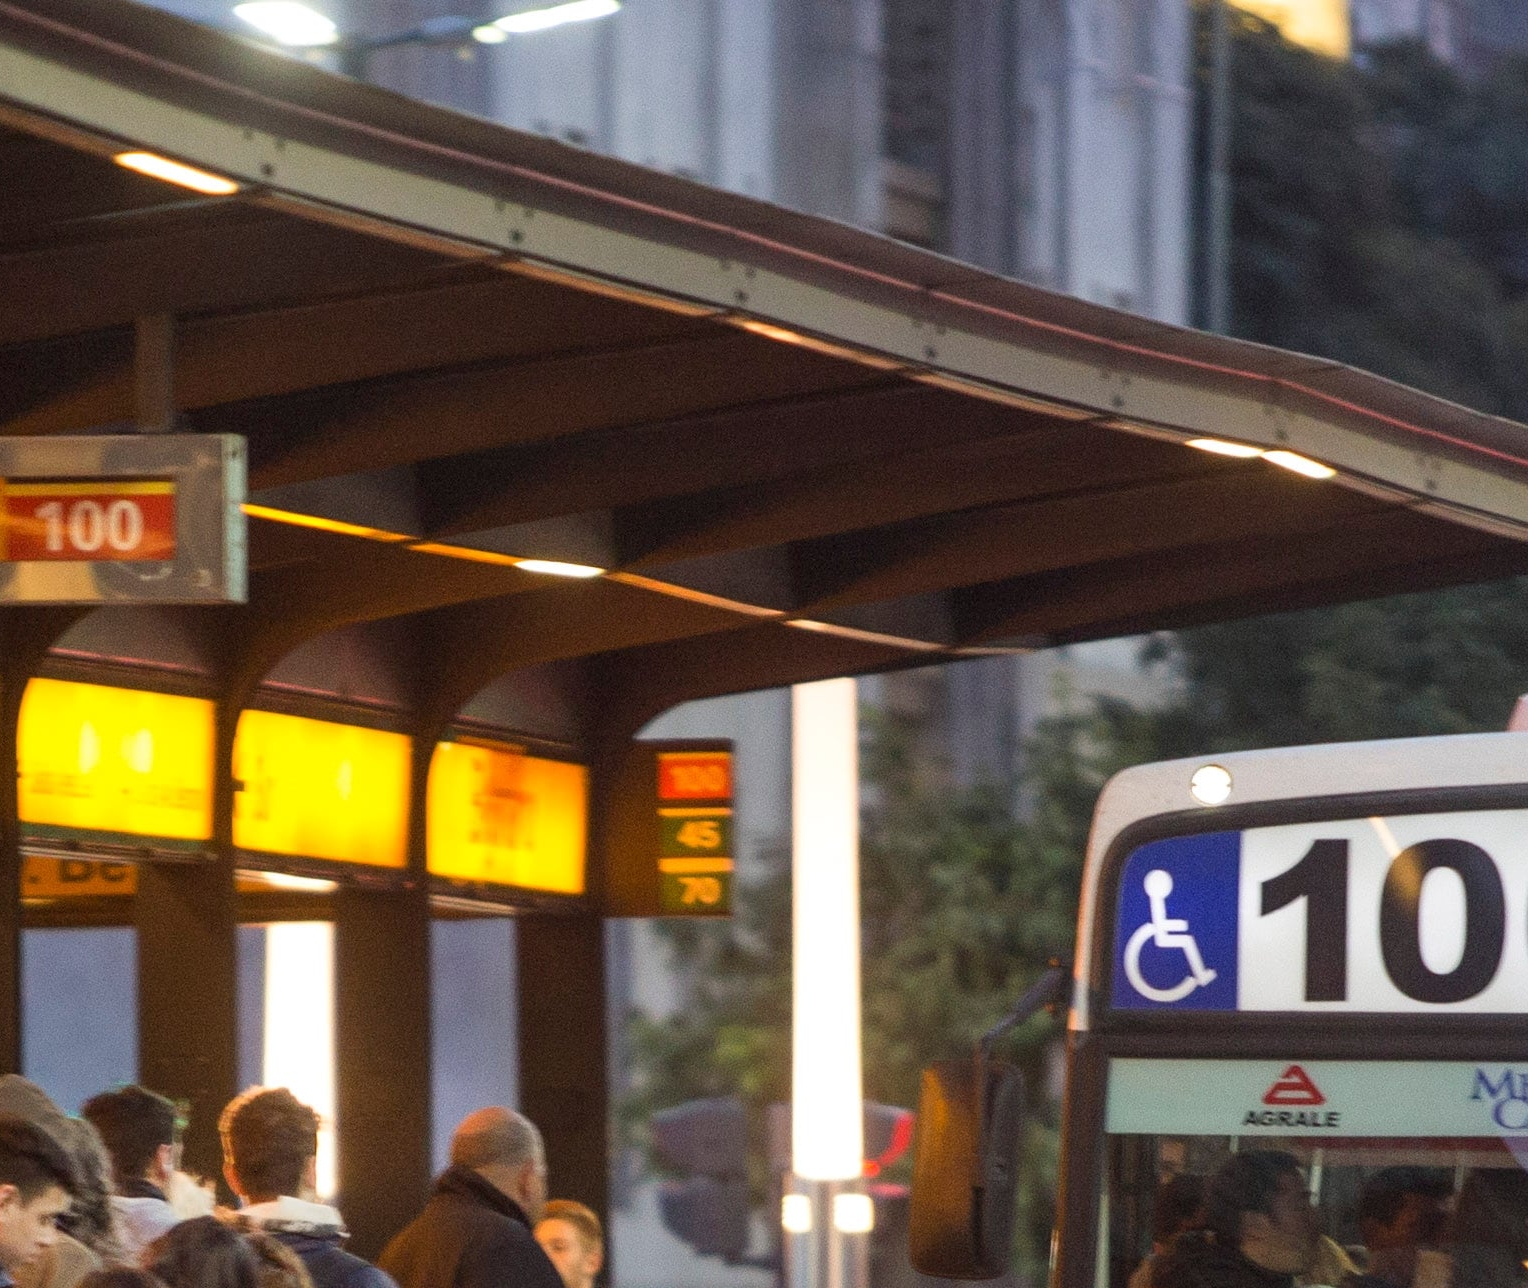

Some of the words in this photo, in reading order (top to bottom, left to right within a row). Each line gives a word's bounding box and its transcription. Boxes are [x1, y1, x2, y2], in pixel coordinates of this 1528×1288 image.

[36, 500, 144, 551] 100
[676, 821, 722, 849] 45
[678, 877, 722, 905] 70
[1242, 1109, 1341, 1128] AGRALE
